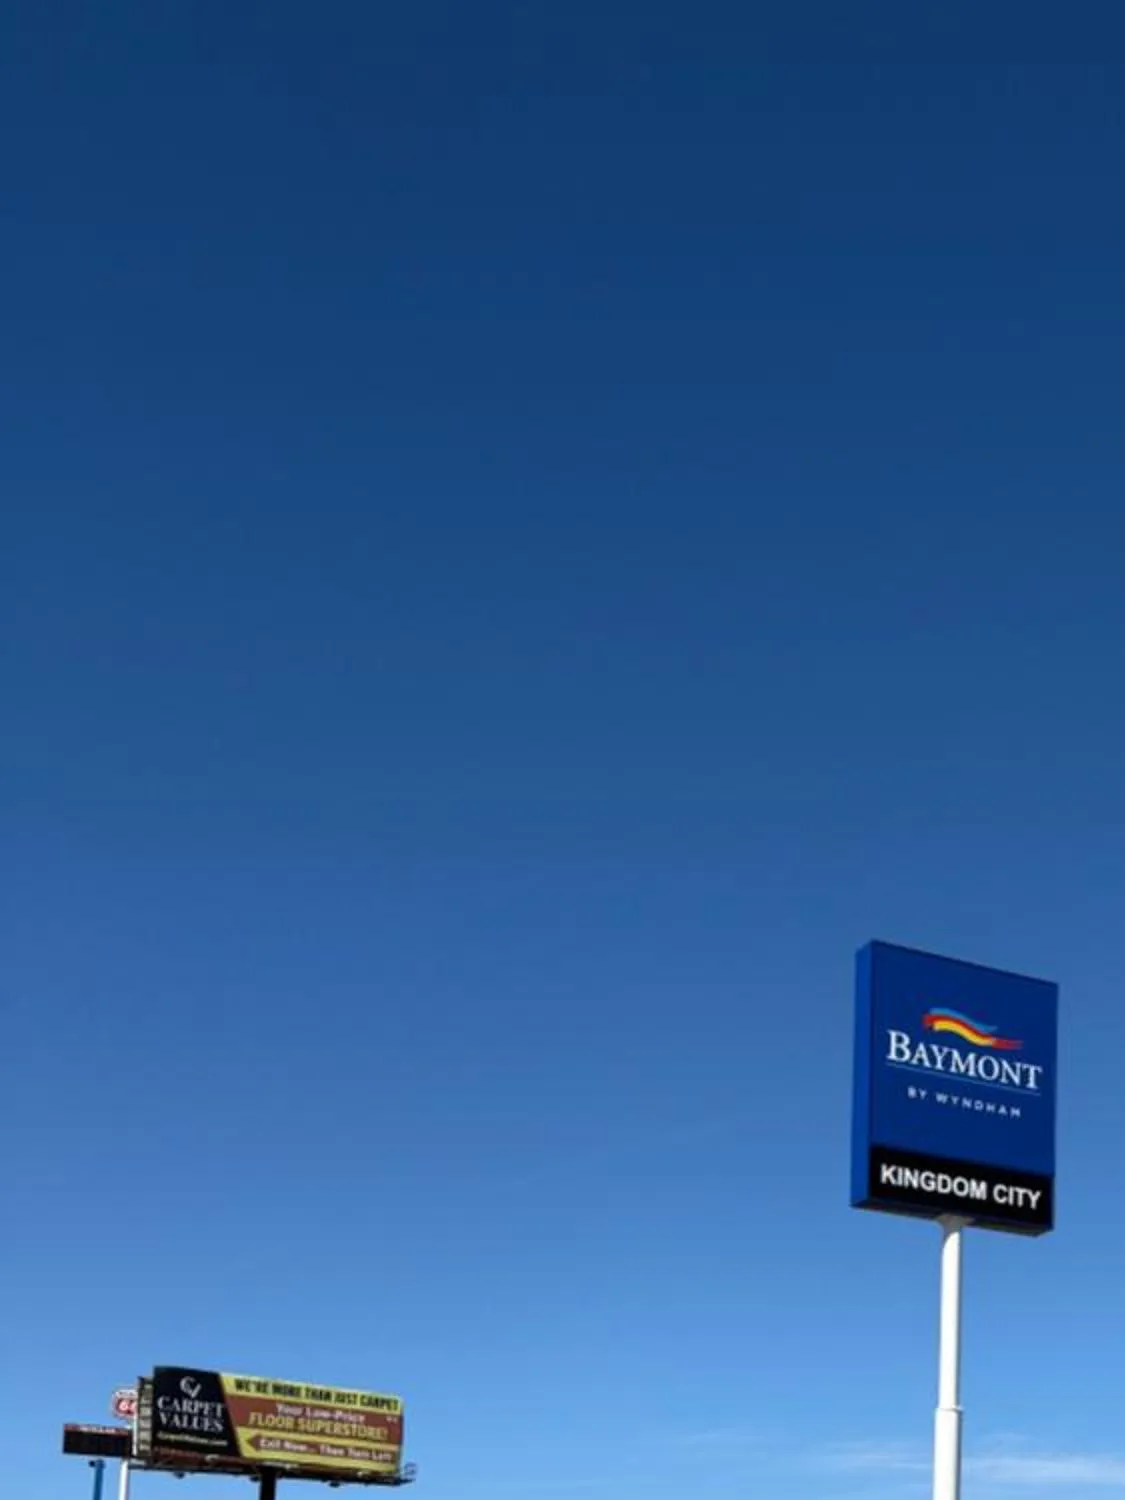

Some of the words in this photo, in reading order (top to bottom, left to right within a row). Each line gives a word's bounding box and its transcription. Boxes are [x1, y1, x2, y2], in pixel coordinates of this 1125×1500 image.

[887, 1030, 1043, 1089] BAYMONT
[908, 1086, 928, 1100] BY
[936, 1092, 1021, 1118] WYNDHAM
[880, 1163, 987, 1200] KINGDOM
[993, 1184, 1042, 1209] CITY
[157, 1395, 224, 1418] CARPET
[159, 1411, 223, 1433] VALUES
[249, 1411, 293, 1430] FLOOR
